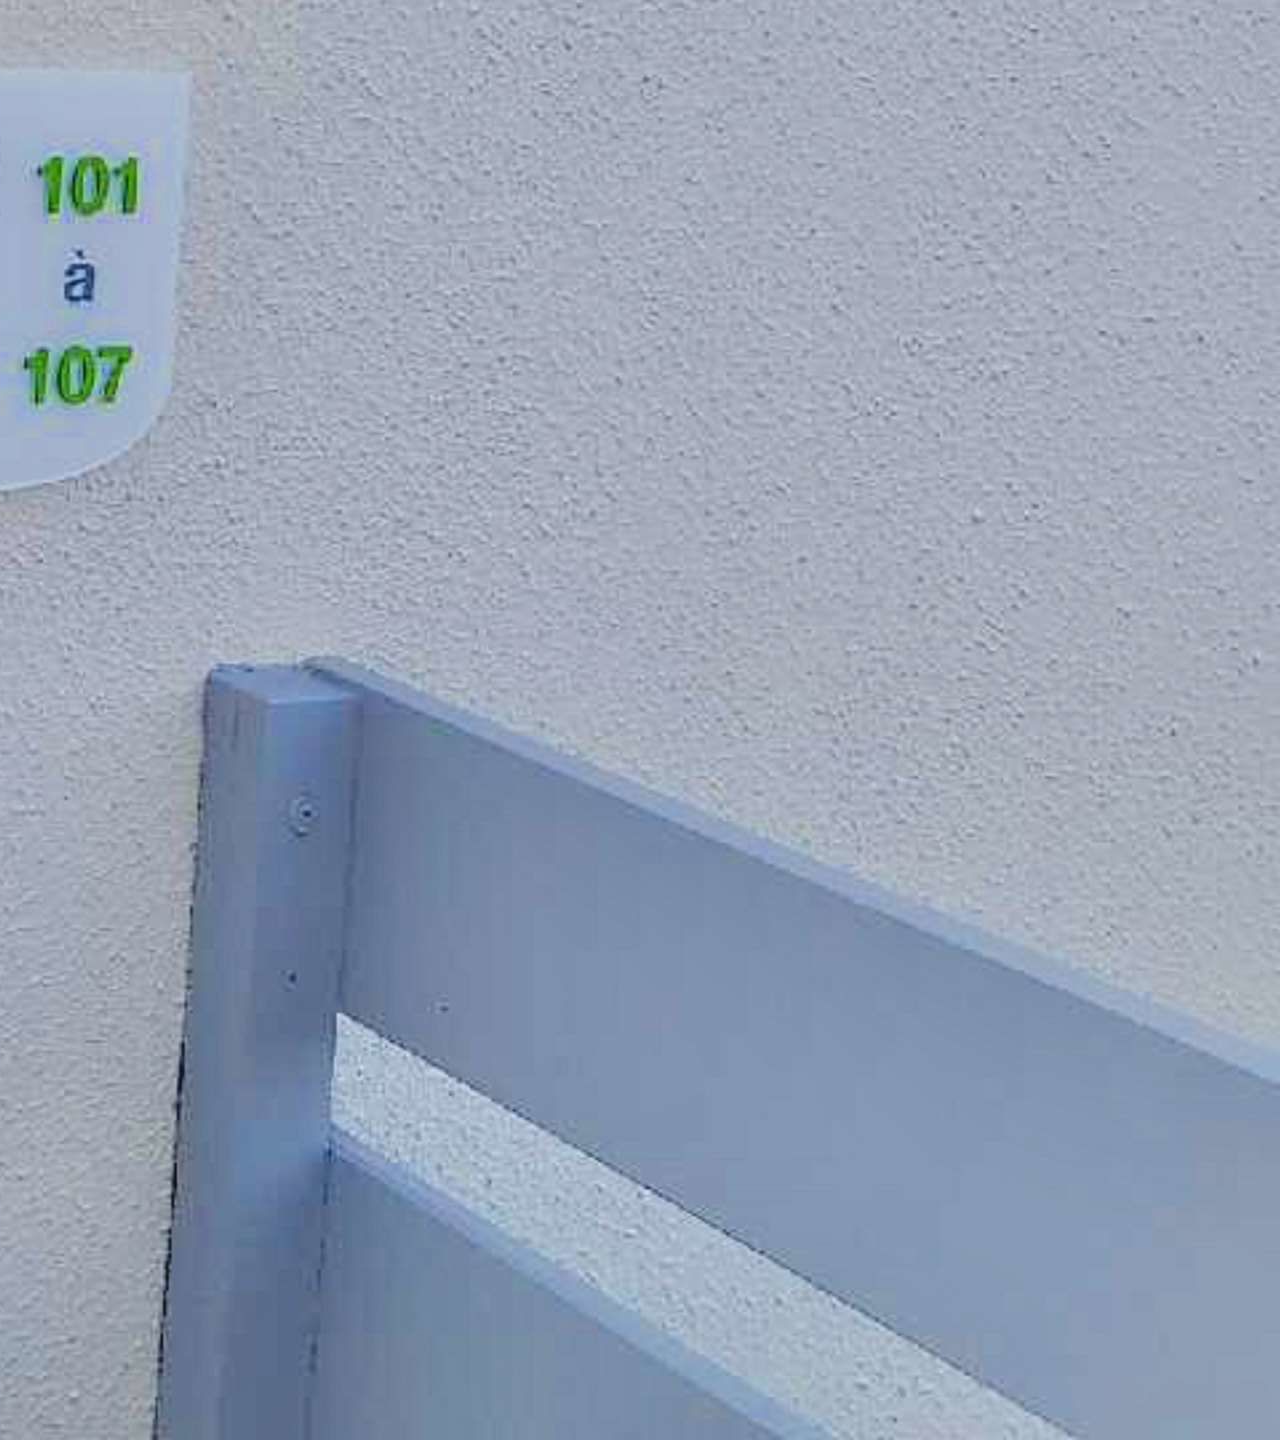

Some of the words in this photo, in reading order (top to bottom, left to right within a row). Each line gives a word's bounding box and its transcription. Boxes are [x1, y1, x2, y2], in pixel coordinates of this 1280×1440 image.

[38, 156, 139, 215] 101
[63, 250, 95, 303] à
[24, 346, 133, 404] 107
